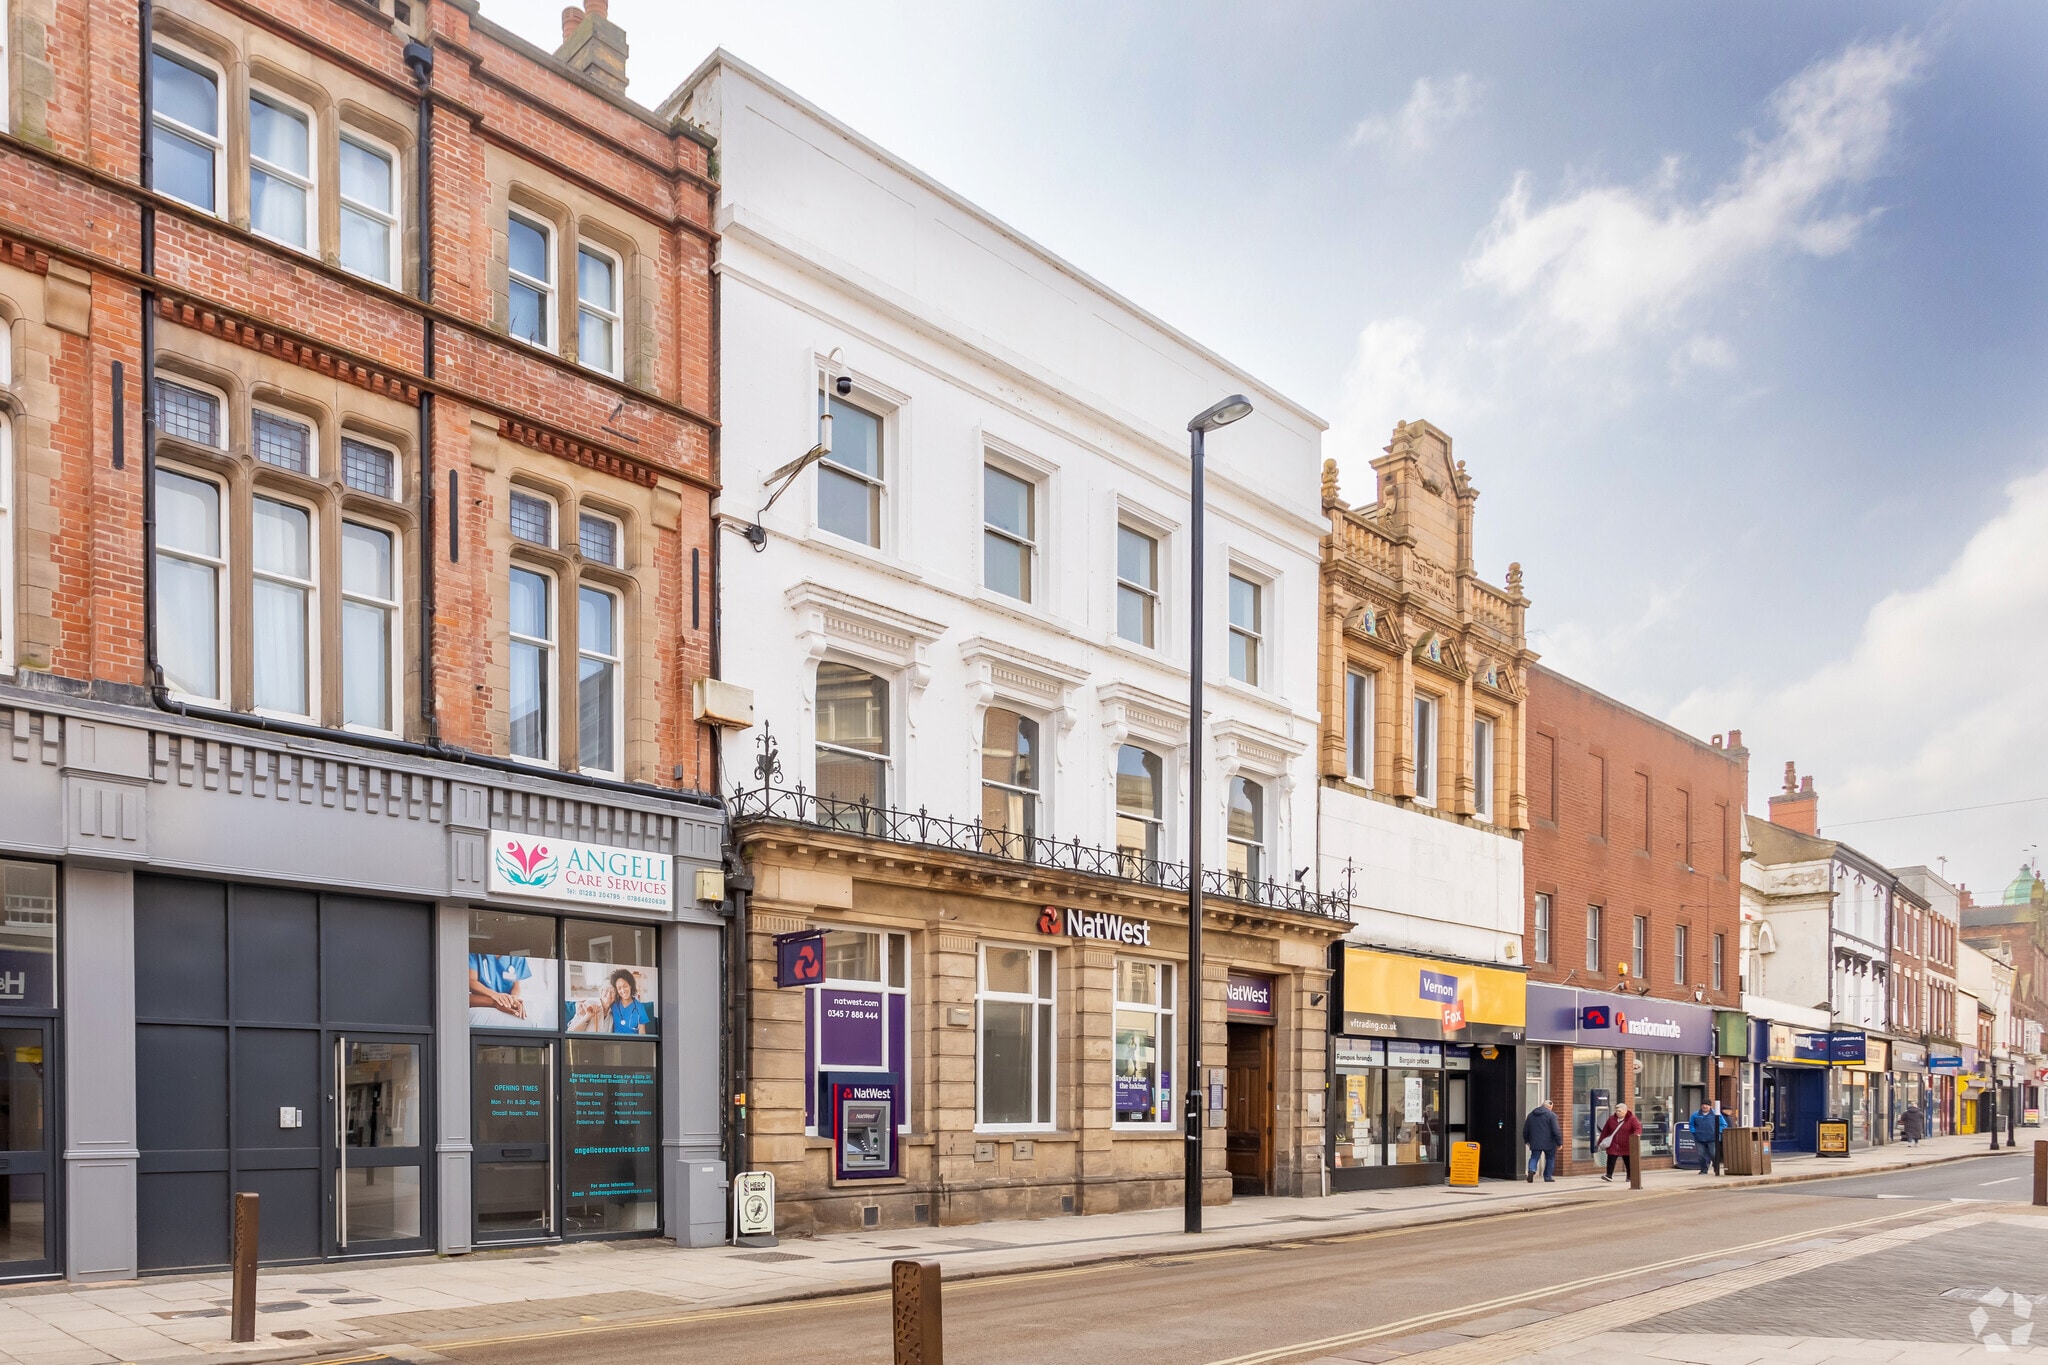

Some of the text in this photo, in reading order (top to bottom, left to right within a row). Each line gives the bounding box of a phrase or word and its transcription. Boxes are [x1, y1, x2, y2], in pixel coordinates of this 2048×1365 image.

[566, 848, 666, 881] ANGELI
[566, 870, 666, 895] CARE SERVICES
[1068, 908, 1150, 946] NatWest
[1226, 984, 1268, 1004] NatWest
[1423, 978, 1453, 997] Vernon
[834, 998, 878, 1007] natwest.com
[828, 1010, 844, 1018] 0345
[1444, 1010, 1462, 1024] Fox
[1350, 1018, 1397, 1031] vftrading.co.uk
[1628, 1017, 1680, 1038] nationwide
[1356, 1054, 1372, 1062] brands
[1400, 1056, 1415, 1065] Bargain
[1116, 1075, 1132, 1083] Today
[854, 1088, 891, 1098] NatWest
[1129, 1083, 1147, 1091] taking
